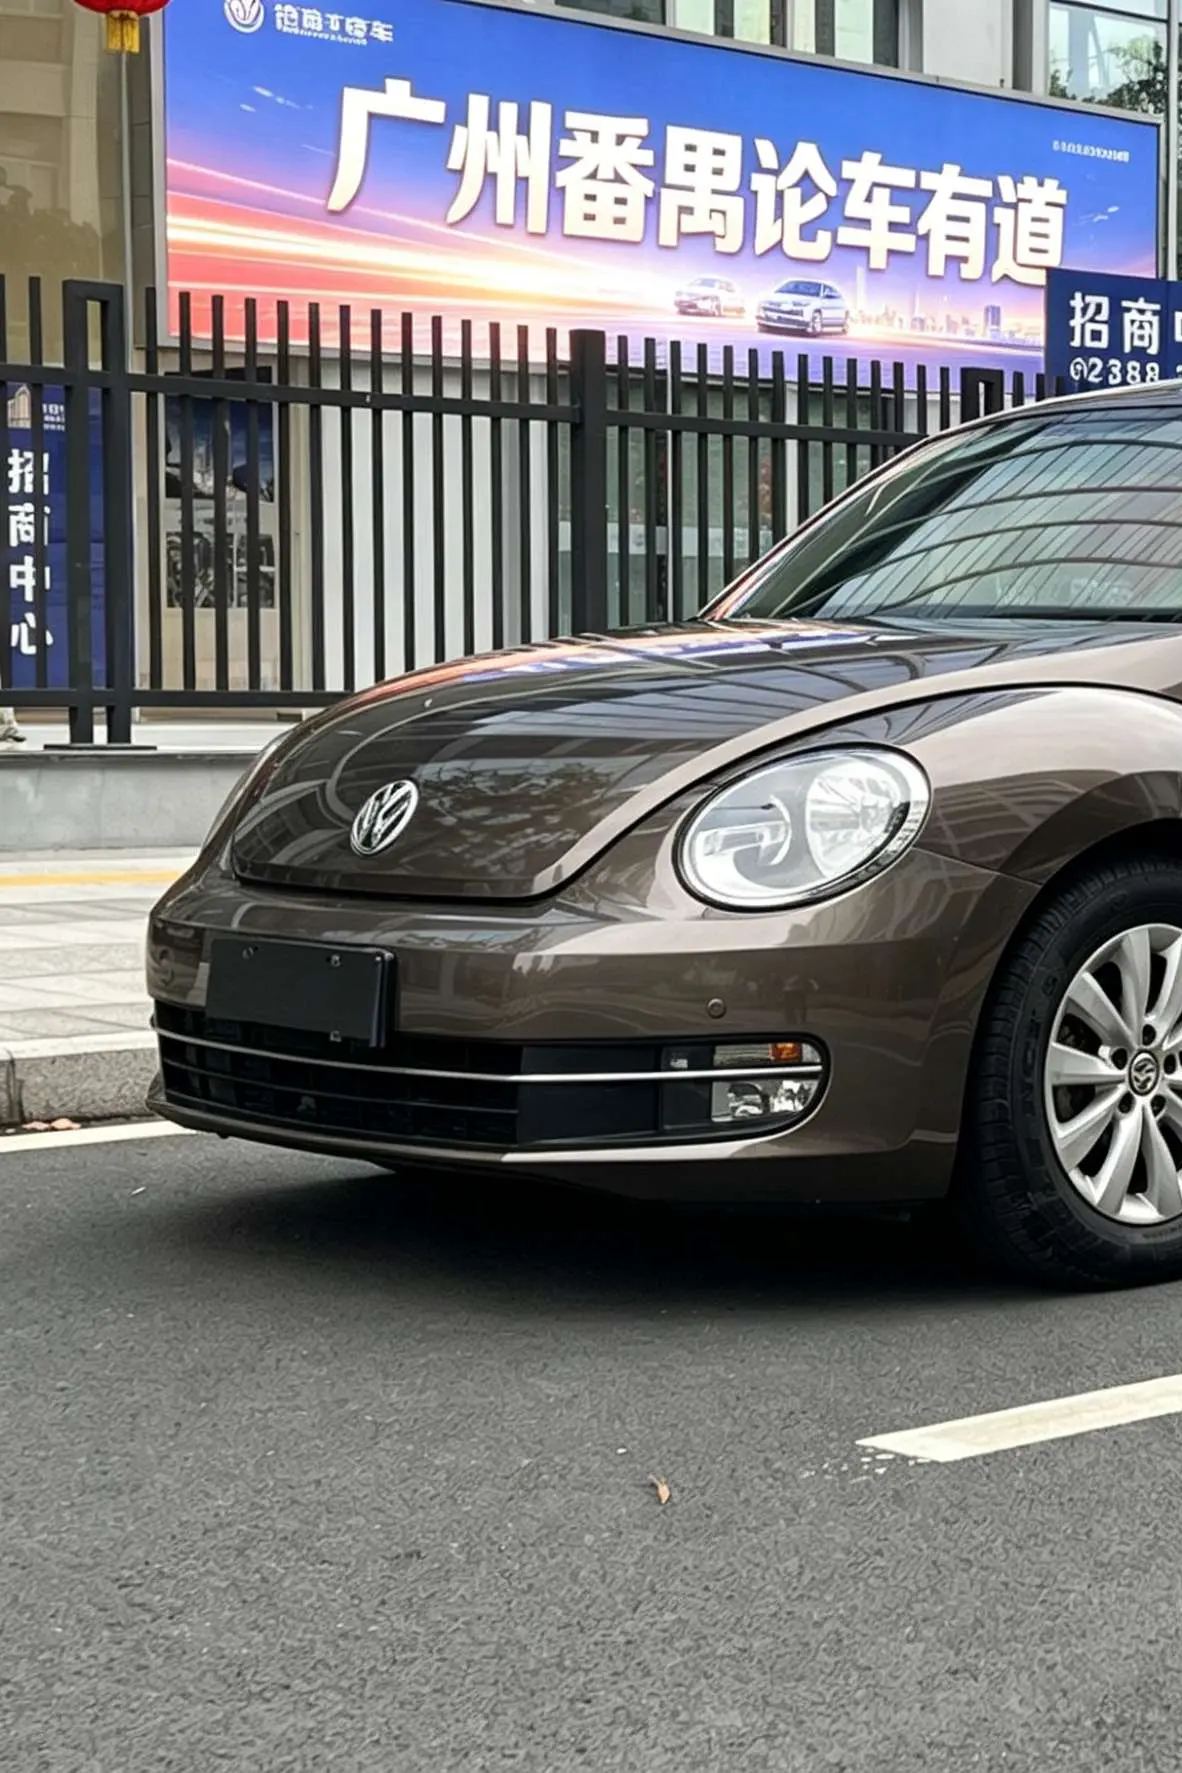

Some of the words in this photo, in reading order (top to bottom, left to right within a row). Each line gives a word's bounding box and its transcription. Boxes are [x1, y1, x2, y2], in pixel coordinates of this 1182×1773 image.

[327, 77, 1068, 287] 广州番禺论车有道
[8, 448, 54, 655] 招商中心
